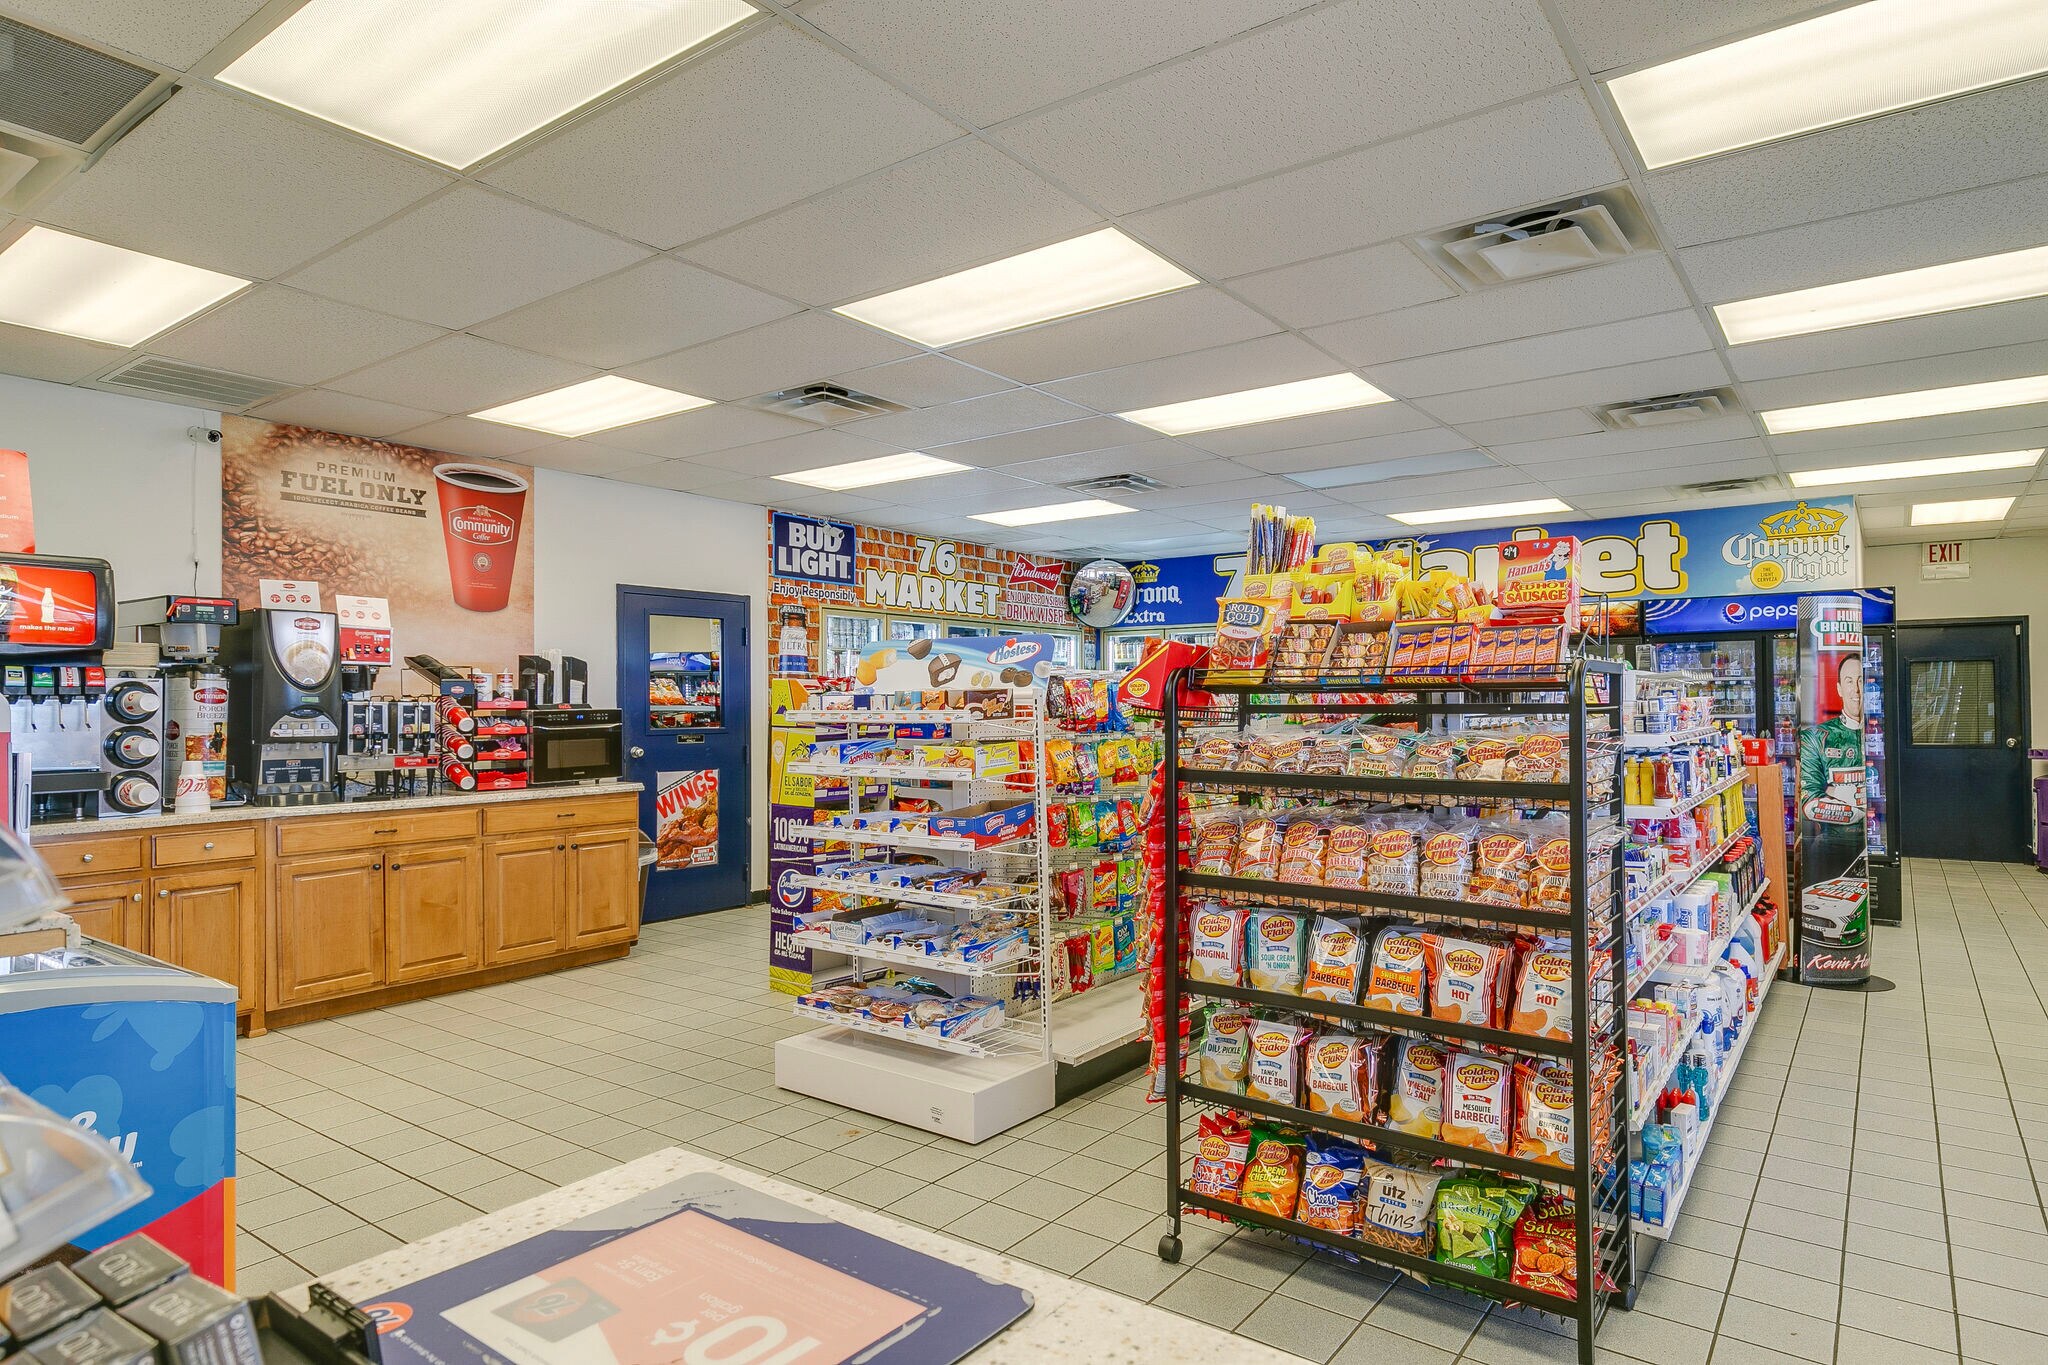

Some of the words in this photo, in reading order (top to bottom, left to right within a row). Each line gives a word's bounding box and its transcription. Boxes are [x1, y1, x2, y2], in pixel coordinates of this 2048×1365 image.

[317, 462, 395, 482] PREMIUM
[281, 470, 353, 496] FUEL
[360, 482, 427, 505] ONLY
[293, 494, 312, 503] 100%
[313, 497, 339, 506] SELECT
[339, 500, 369, 510] ARABICA
[370, 504, 394, 513] COFFEE
[395, 507, 417, 516] BEANS
[452, 516, 511, 537] Community
[472, 532, 491, 541] Coffee
[788, 521, 844, 553] BUD
[1721, 532, 1849, 568] Corona
[1929, 543, 1962, 563] EXIT
[916, 536, 959, 577] 76
[1013, 560, 1061, 583] Budweiser
[1507, 558, 1551, 578] Hannah's
[1783, 555, 1848, 583] Light
[1509, 581, 1534, 591] RED
[1535, 581, 1567, 589] HOT
[773, 583, 800, 599] Enjoy
[802, 585, 856, 602] Responsibly
[865, 568, 1000, 617] MARKET
[1007, 590, 1026, 601] ENJOY
[1506, 589, 1567, 603] SAUSAGE
[1006, 604, 1036, 620] DRINK
[1230, 603, 1260, 615] ROLD
[1750, 604, 1798, 620] peps
[1226, 611, 1260, 626] GOLD
[996, 643, 1038, 662] Hostess
[1393, 676, 1449, 684] SNACKERS
[199, 705, 226, 713] PORCH
[1273, 740, 1301, 752] Golden
[1275, 748, 1299, 758] Flake
[1362, 762, 1387, 770] SUPER
[784, 776, 792, 787] EL
[791, 777, 813, 788] SABOR
[656, 769, 718, 819] WINGS
[1204, 822, 1238, 832] Golden
[1286, 823, 1317, 837] Golden
[1206, 829, 1233, 838] Flake
[1330, 830, 1366, 841] Golden
[1372, 833, 1411, 844] Golden
[1332, 838, 1365, 850] Flake
[1378, 842, 1412, 853] Flake
[1426, 840, 1464, 850] Golden
[1481, 838, 1522, 850] Golden
[1431, 847, 1467, 859] Flake
[1485, 847, 1522, 858] Flake
[1372, 865, 1382, 873] OLD
[1482, 867, 1519, 881] LOUISIANA
[1333, 876, 1358, 885] FRIED
[1422, 873, 1434, 881] OLD
[1382, 881, 1406, 890] FRIED
[1481, 880, 1495, 888] HOT
[1495, 882, 1518, 892] SAUCE
[1433, 888, 1458, 897] FRIED
[1199, 915, 1230, 925] Golden
[1260, 917, 1293, 929] Golden
[1202, 923, 1229, 933] Flake
[1266, 927, 1294, 938] Flake
[1322, 933, 1357, 945] Golden
[1386, 937, 1423, 950] Golden
[1195, 948, 1229, 960] ORIGINAL
[1388, 945, 1419, 955] Flake
[1260, 953, 1276, 962] SOUR
[1276, 954, 1296, 963] CREAM
[1447, 954, 1481, 964] Golden
[1535, 953, 1572, 967] Golden
[1807, 953, 1852, 969] Kevin
[1331, 967, 1347, 976] HEAT
[1452, 962, 1480, 972] Flake
[1311, 971, 1350, 987] BARBECUE
[1381, 970, 1398, 979] SWEET
[1398, 973, 1413, 982] HEAT
[1375, 977, 1416, 994] BARBECUE
[1451, 988, 1470, 1002] HOT
[1536, 993, 1558, 1007] HOT
[1214, 1014, 1243, 1024] Golden
[1218, 1021, 1243, 1031] Flake
[1256, 1033, 1290, 1044] Golden
[1208, 1043, 1222, 1052] DILL
[1221, 1045, 1241, 1055] PICKLE
[1259, 1042, 1289, 1053] Flake
[1319, 1044, 1349, 1057] Golden
[1323, 1053, 1348, 1064] Flake
[1261, 1067, 1278, 1076] TANGY
[1459, 1066, 1498, 1077] Golden
[1273, 1076, 1289, 1088] BBQ
[1312, 1079, 1349, 1092] BARBECUE
[1463, 1074, 1496, 1085] Flake
[1413, 1091, 1432, 1102] SALT
[1542, 1092, 1574, 1104] Flake
[1462, 1103, 1492, 1113] MESQUITE
[1454, 1110, 1500, 1126] BARBECUE
[1538, 1120, 1568, 1132] BUFFALO
[1536, 1126, 1569, 1144] RANCH
[1201, 1137, 1230, 1149] Golden
[1259, 1140, 1288, 1152] Golden
[1202, 1146, 1229, 1158] Flake
[1259, 1150, 1286, 1161] Flake
[1194, 1181, 1221, 1195] CURLS
[1382, 1184, 1406, 1201] utz
[1307, 1187, 1338, 1207] Cheese
[1384, 1198, 1403, 1207] EXTRA
[1308, 1205, 1339, 1219] PUFFS
[1368, 1203, 1415, 1230] Thins
[1444, 1257, 1477, 1272] Guacamole
[525, 1291, 576, 1317] 76
[698, 1291, 744, 1316] gallon
[699, 1308, 731, 1323] per
